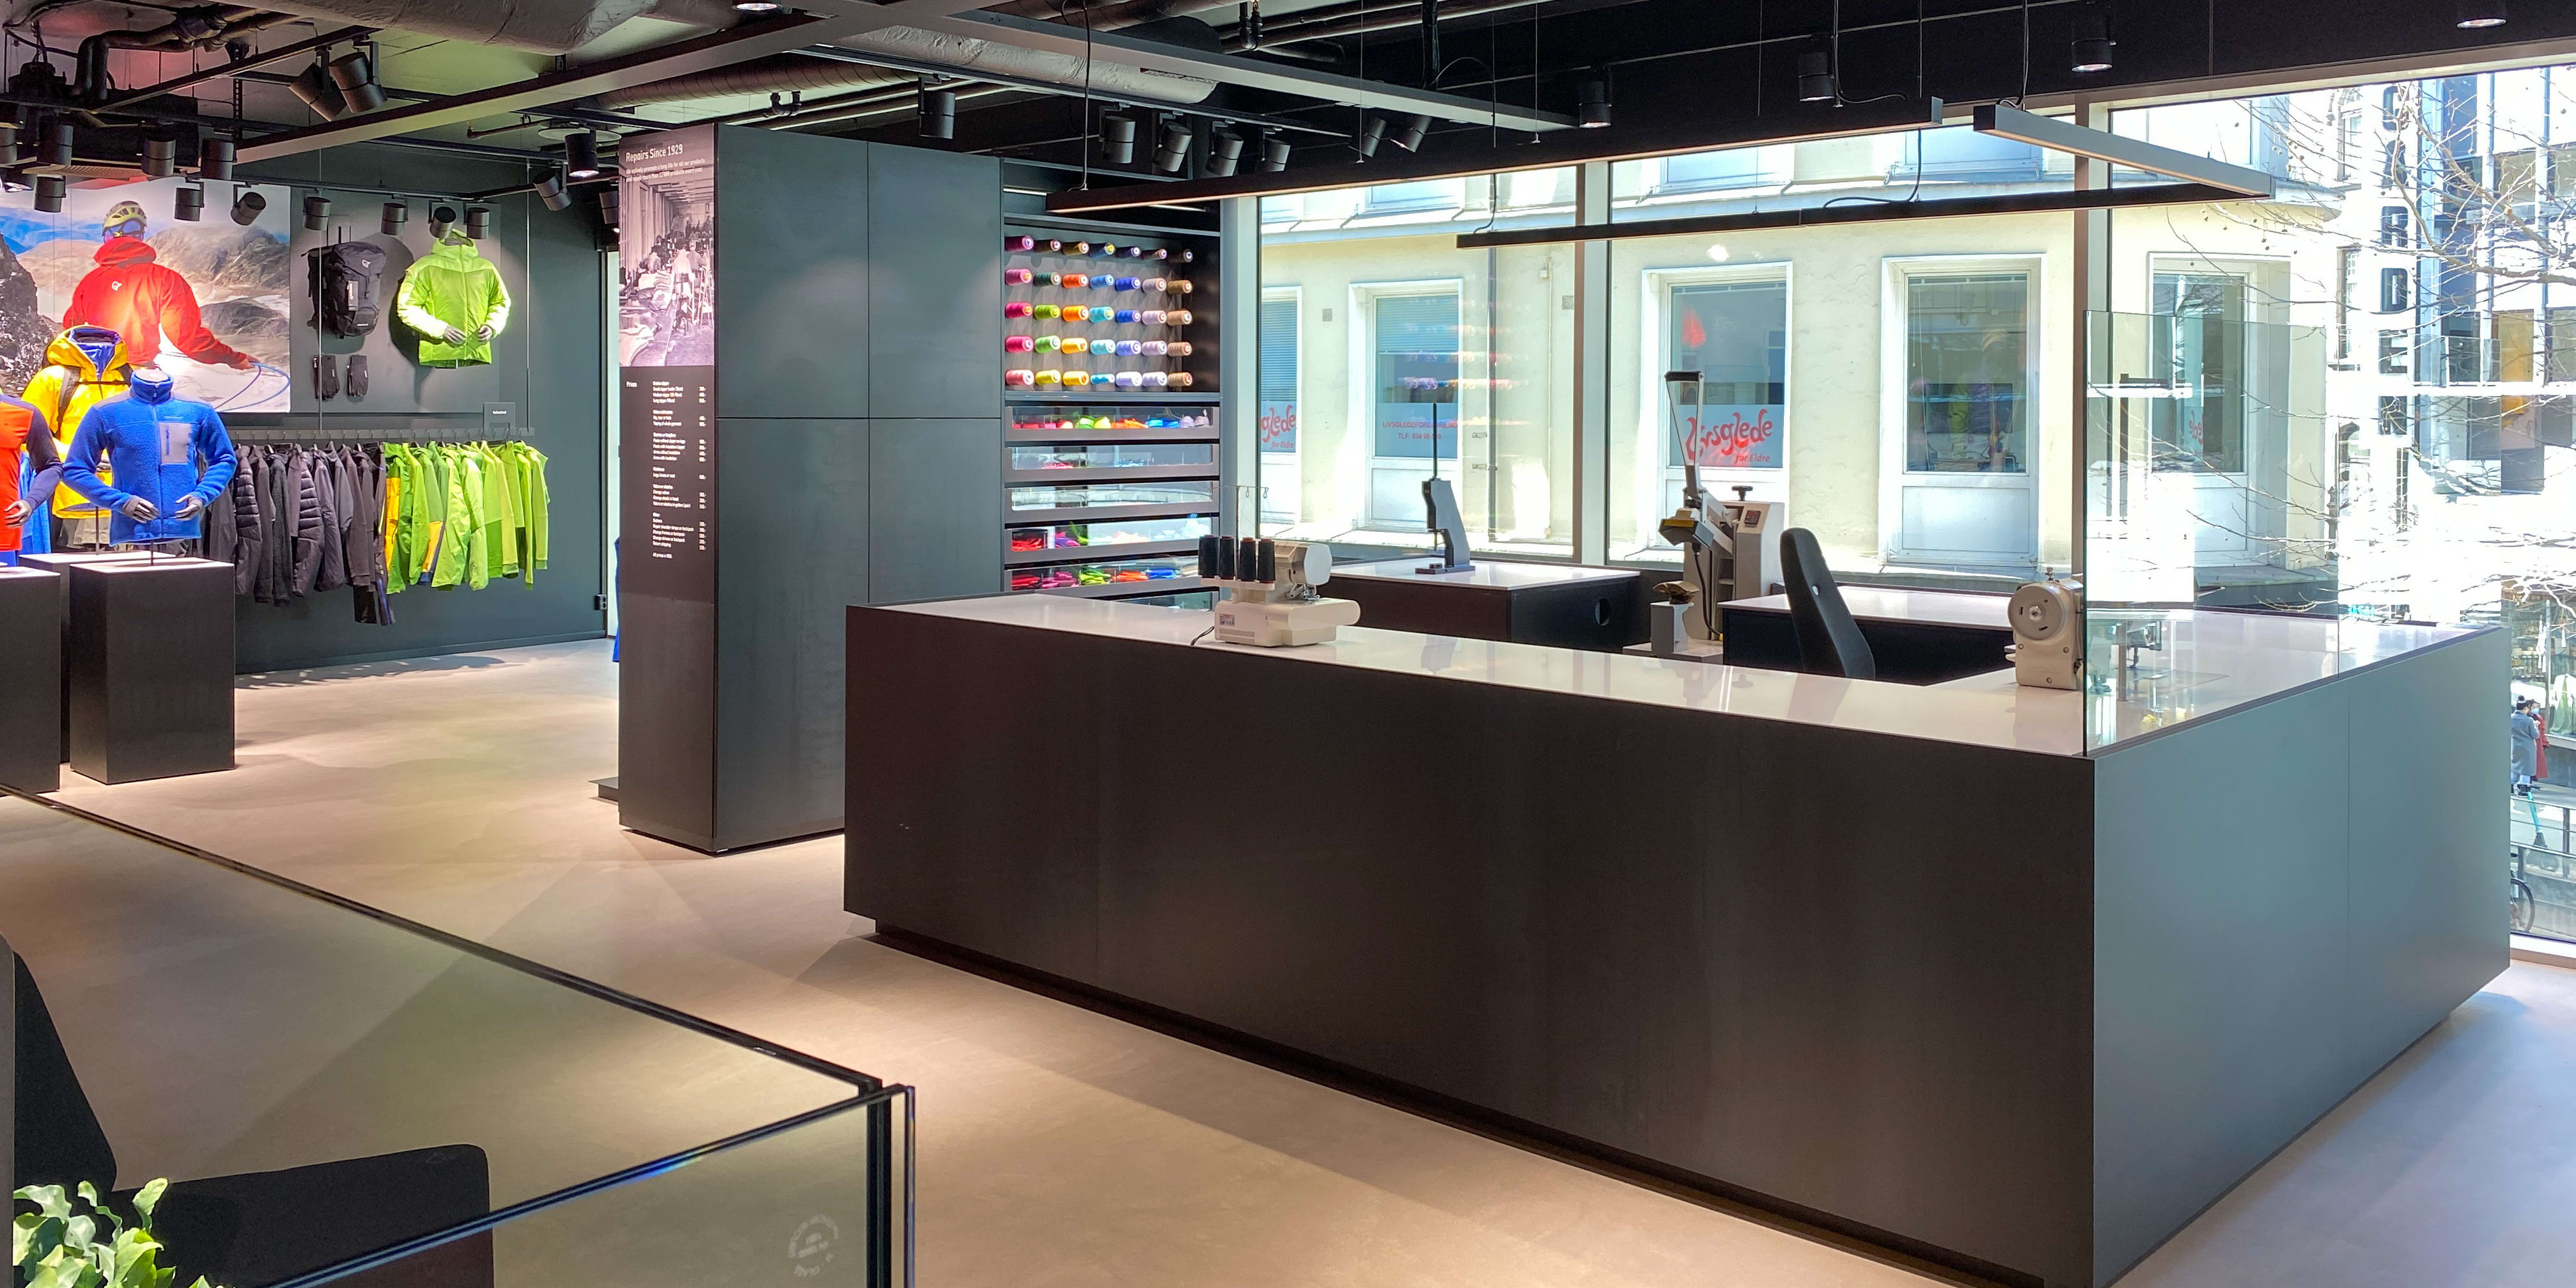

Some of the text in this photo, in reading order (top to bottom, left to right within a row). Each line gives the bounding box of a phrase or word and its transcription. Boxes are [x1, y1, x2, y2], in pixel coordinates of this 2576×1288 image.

[625, 143, 683, 164] Repairs Since 1929
[1749, 453, 1770, 462] Eldre
